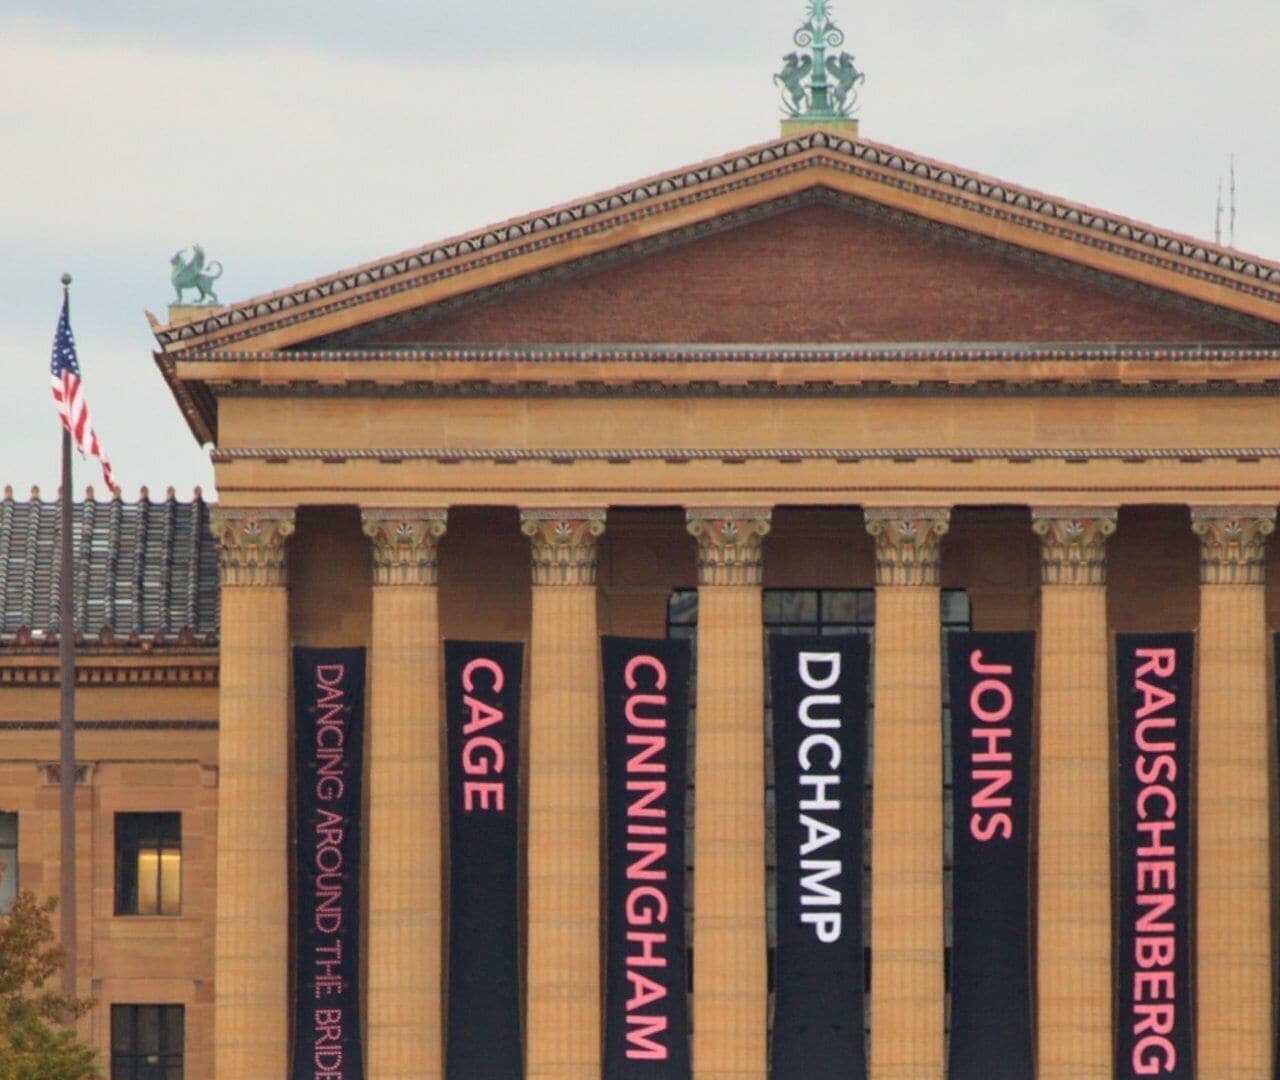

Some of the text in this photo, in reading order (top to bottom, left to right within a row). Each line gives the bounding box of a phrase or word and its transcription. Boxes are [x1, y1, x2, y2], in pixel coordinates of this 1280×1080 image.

[316, 664, 345, 800] DANCING
[462, 658, 506, 812] CAGE
[798, 651, 842, 943] DUCHAMP
[970, 649, 1013, 842] JOHNS
[316, 808, 344, 933] AROUND
[624, 655, 668, 1061] CUNNINGHAM
[1132, 648, 1177, 1076] RAUSCHENBERG
[315, 939, 343, 998] THE
